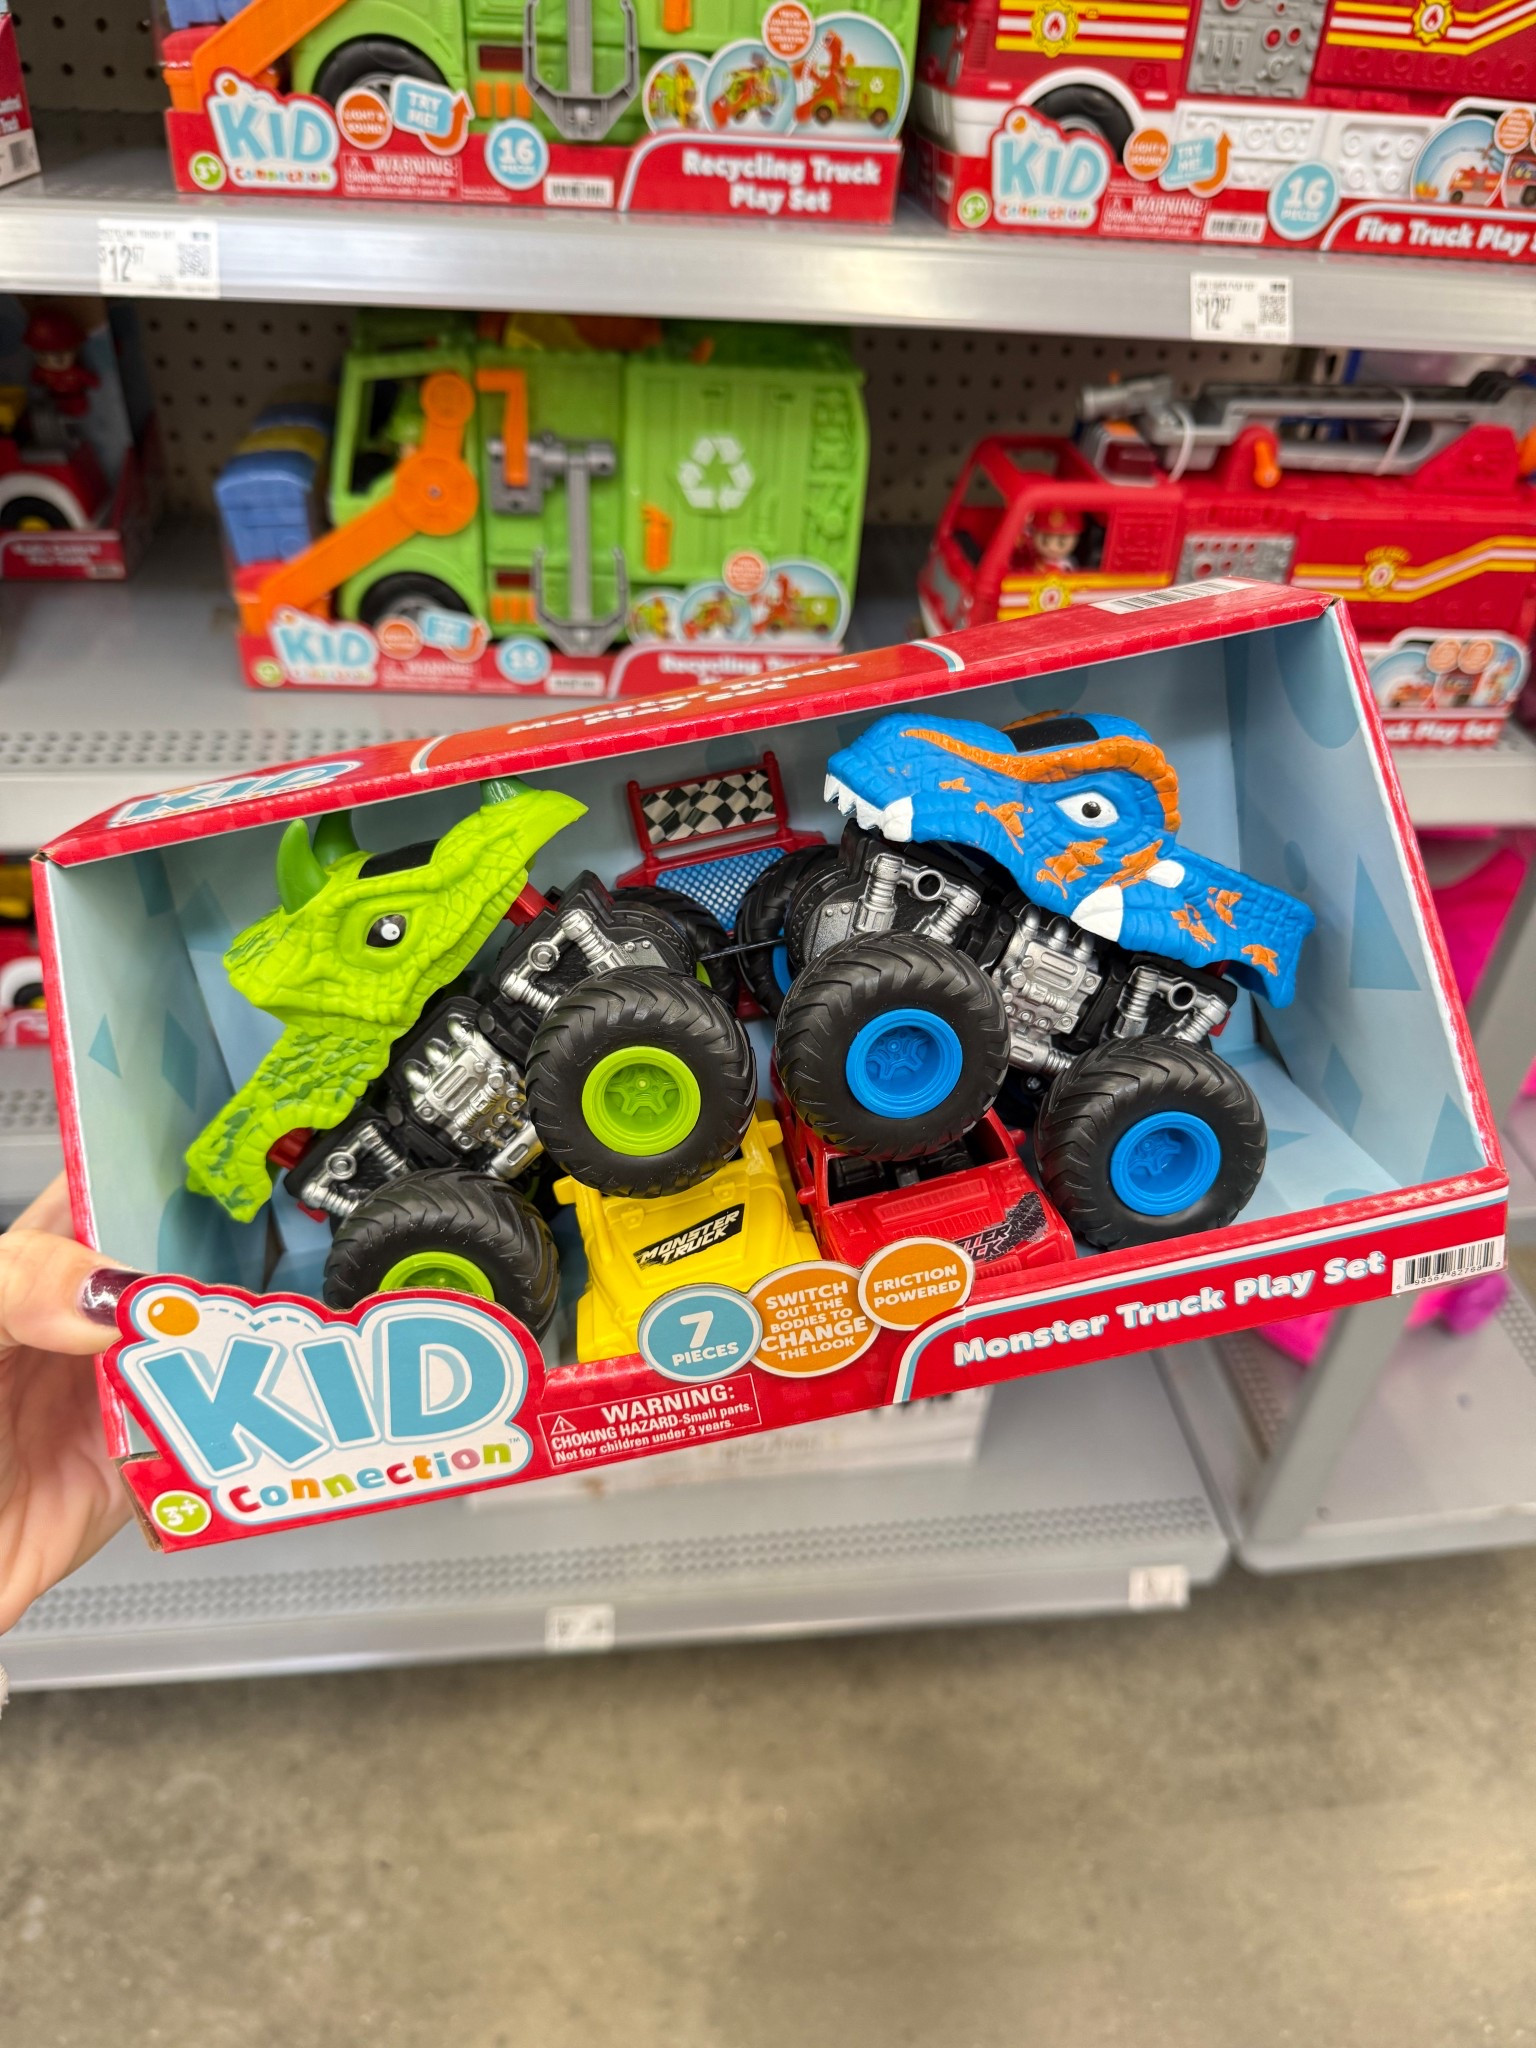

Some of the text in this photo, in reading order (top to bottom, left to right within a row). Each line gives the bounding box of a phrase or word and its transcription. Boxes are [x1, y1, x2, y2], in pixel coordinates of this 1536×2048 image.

[407, 109, 438, 129] ME!
[408, 91, 441, 111] TRY
[217, 104, 331, 162] KID
[499, 137, 535, 164] 16
[1178, 143, 1203, 158] TRY
[682, 147, 882, 186] Recycling Truck
[1001, 140, 1101, 199] KID
[729, 181, 832, 215] Play Set
[1284, 176, 1328, 210] 16
[1356, 216, 1405, 242] Fire
[1408, 218, 1474, 247] Truck
[1477, 225, 1528, 257] Play
[280, 628, 372, 668] KID
[507, 691, 709, 734] Monster
[721, 662, 861, 691] Truck
[584, 683, 787, 725] Play Set
[640, 1210, 740, 1264] MONSTER
[661, 1224, 730, 1263] TRUCK
[873, 1264, 958, 1293] FRICTION
[1414, 1273, 1445, 1286] 98567
[1451, 1264, 1482, 1277] 82768
[765, 1281, 848, 1310] SWITCH
[775, 1297, 844, 1320] OUT THE
[873, 1279, 961, 1308] POWERED
[953, 1251, 1386, 1368] Monster Truck Play Set
[680, 1310, 714, 1349] 7
[760, 1316, 868, 1352] CHANGE
[770, 1308, 853, 1334] BODIES TO
[672, 1342, 739, 1367] PIECES
[777, 1336, 855, 1361] THE LOOK
[143, 1316, 507, 1473] KID
[601, 1384, 735, 1424] WARNING:
[551, 1401, 753, 1451] CHOKING HAZARD-Small parts.
[555, 1418, 735, 1464] Not for children under 3 years.
[162, 1499, 199, 1527] 3+
